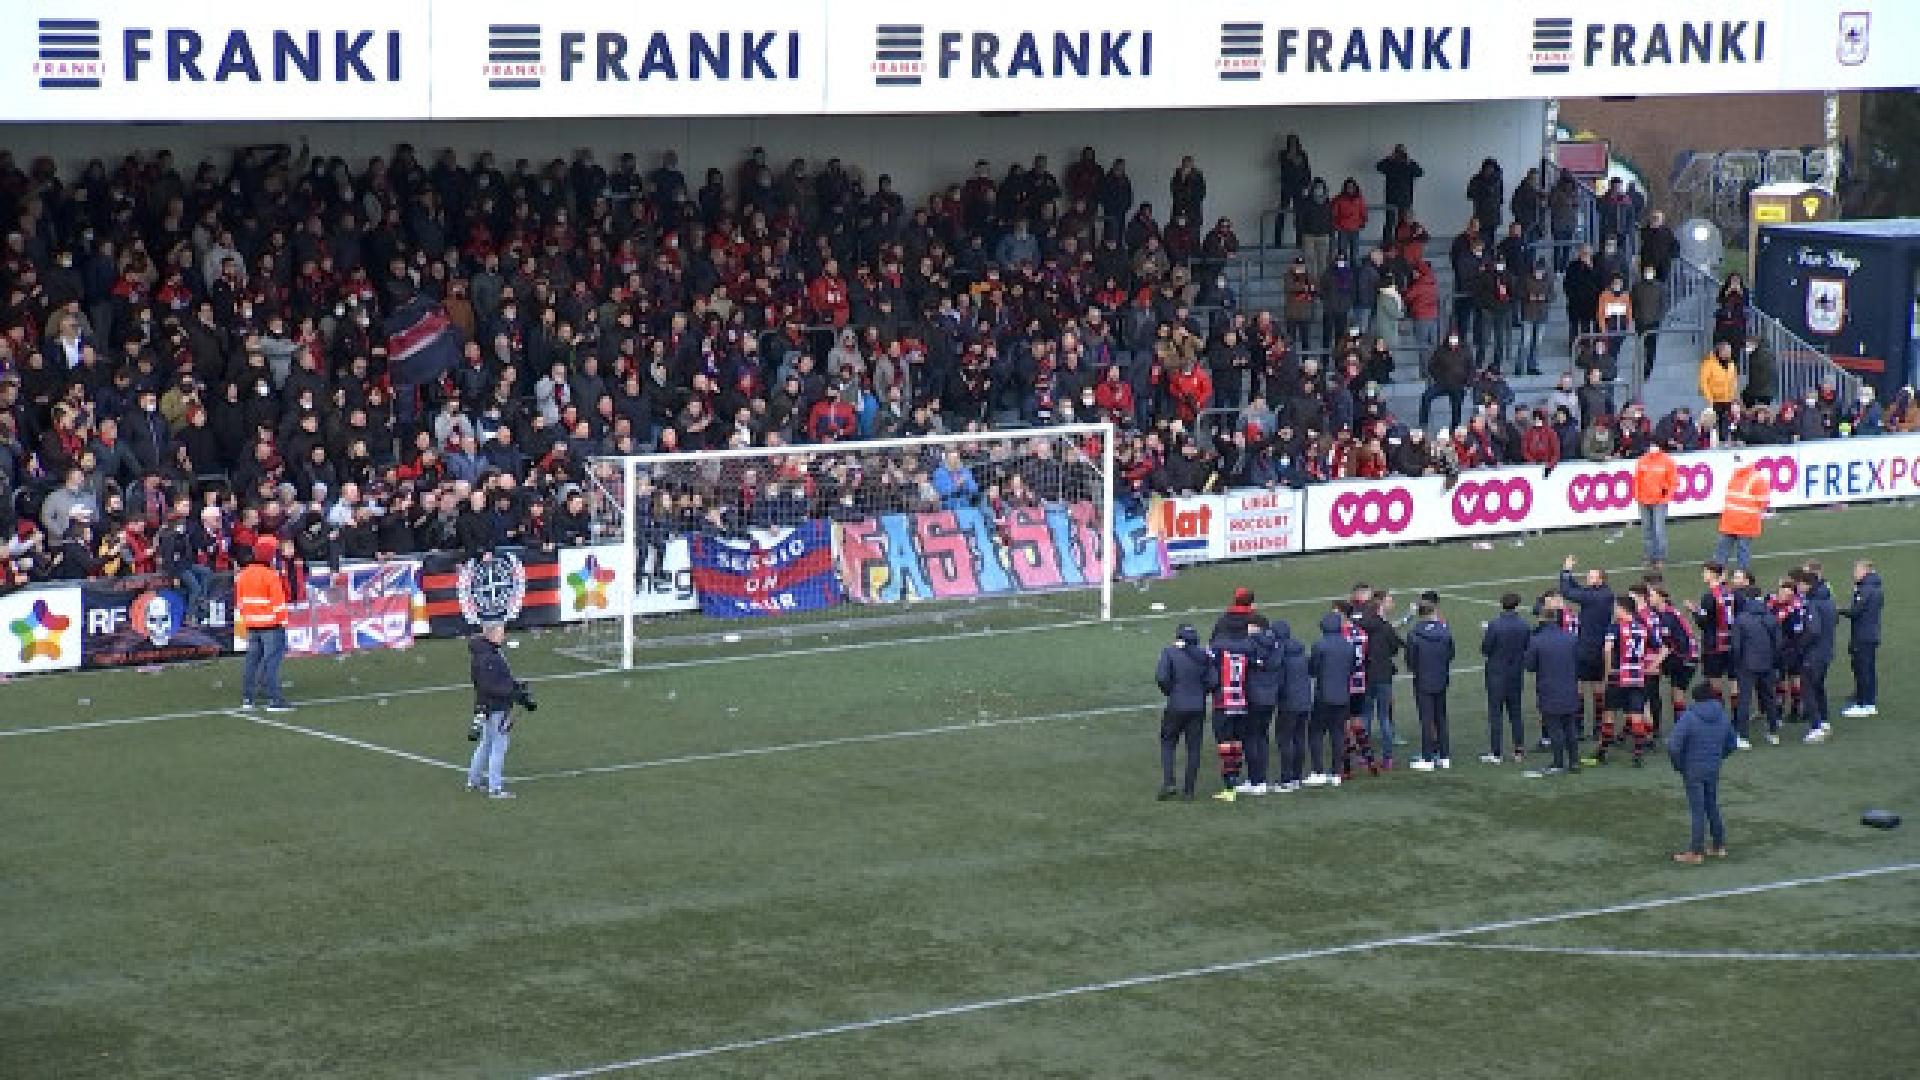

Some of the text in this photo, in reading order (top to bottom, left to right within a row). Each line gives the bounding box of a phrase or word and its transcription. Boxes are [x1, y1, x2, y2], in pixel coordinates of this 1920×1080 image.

[123, 30, 399, 81] FRANKI
[561, 32, 798, 81] FRANKI
[939, 30, 1152, 78] FRANKI
[1278, 27, 1470, 72] FRANKI
[1584, 21, 1764, 66] FRANKI
[88, 606, 127, 634] RF
